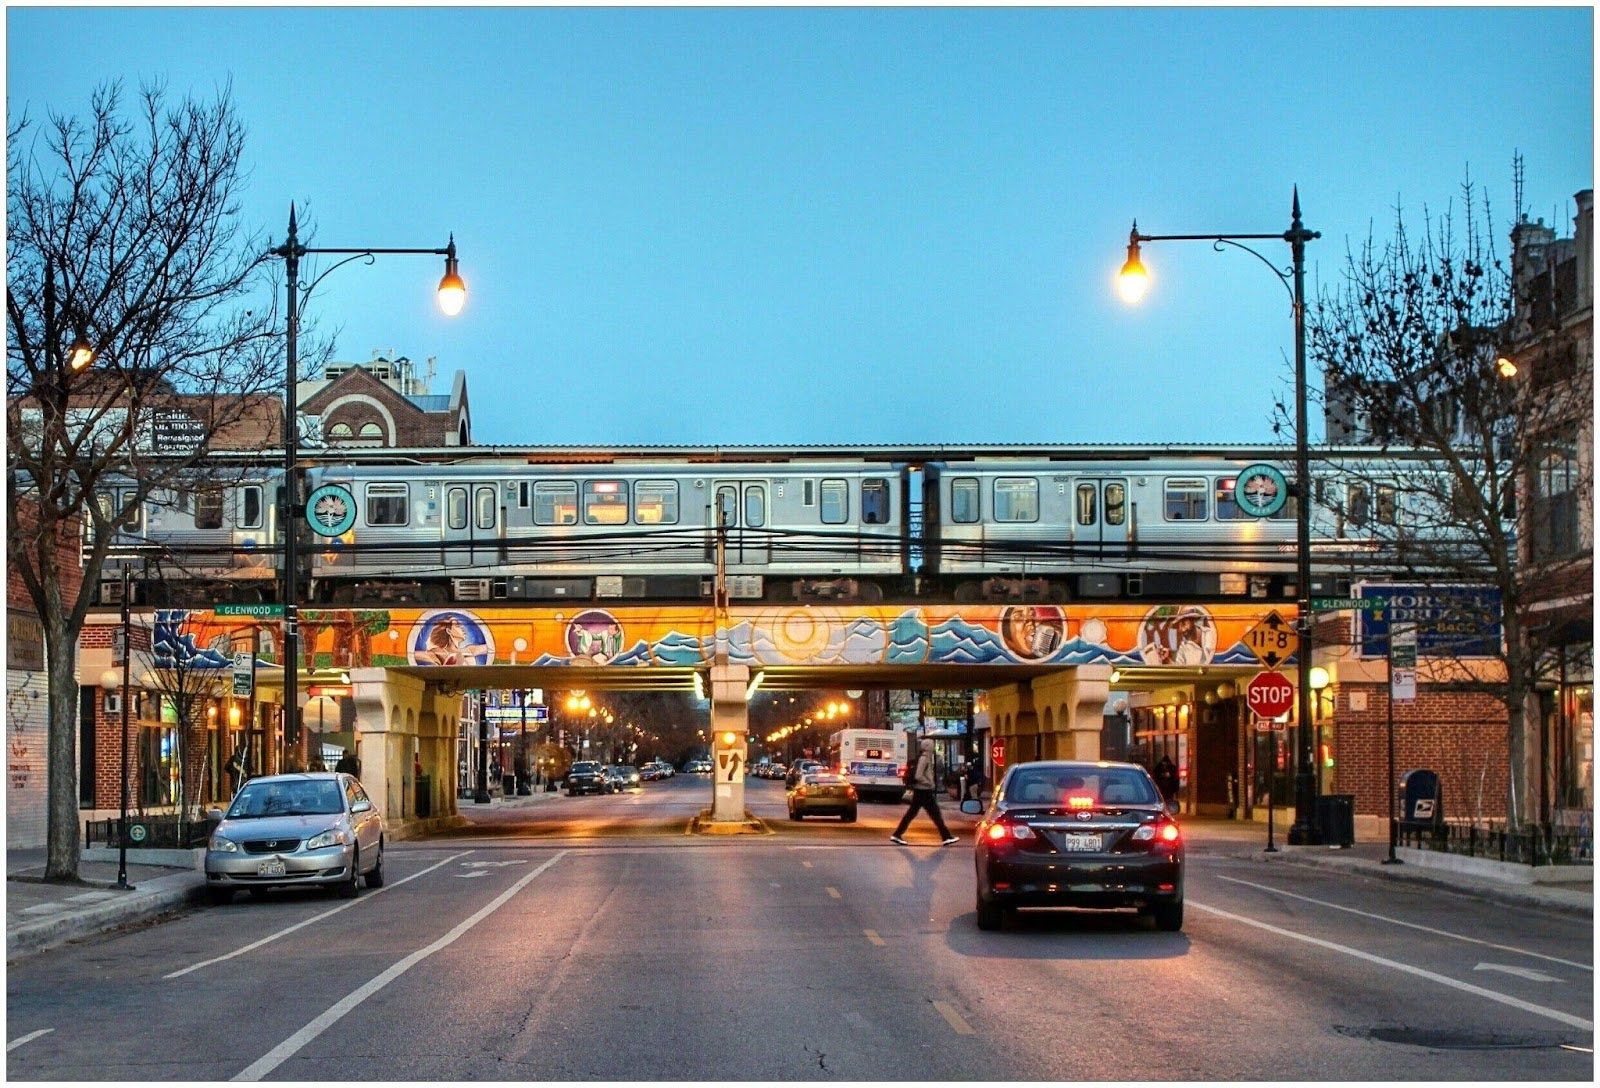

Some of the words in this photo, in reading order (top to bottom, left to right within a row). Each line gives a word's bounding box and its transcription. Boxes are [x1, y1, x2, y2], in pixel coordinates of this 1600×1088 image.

[224, 605, 271, 615] GLENWOOD
[1322, 599, 1370, 609] GLENWOOD
[1250, 686, 1292, 704] STOP
[992, 746, 1005, 758] ST
[1066, 838, 1080, 850] P99
